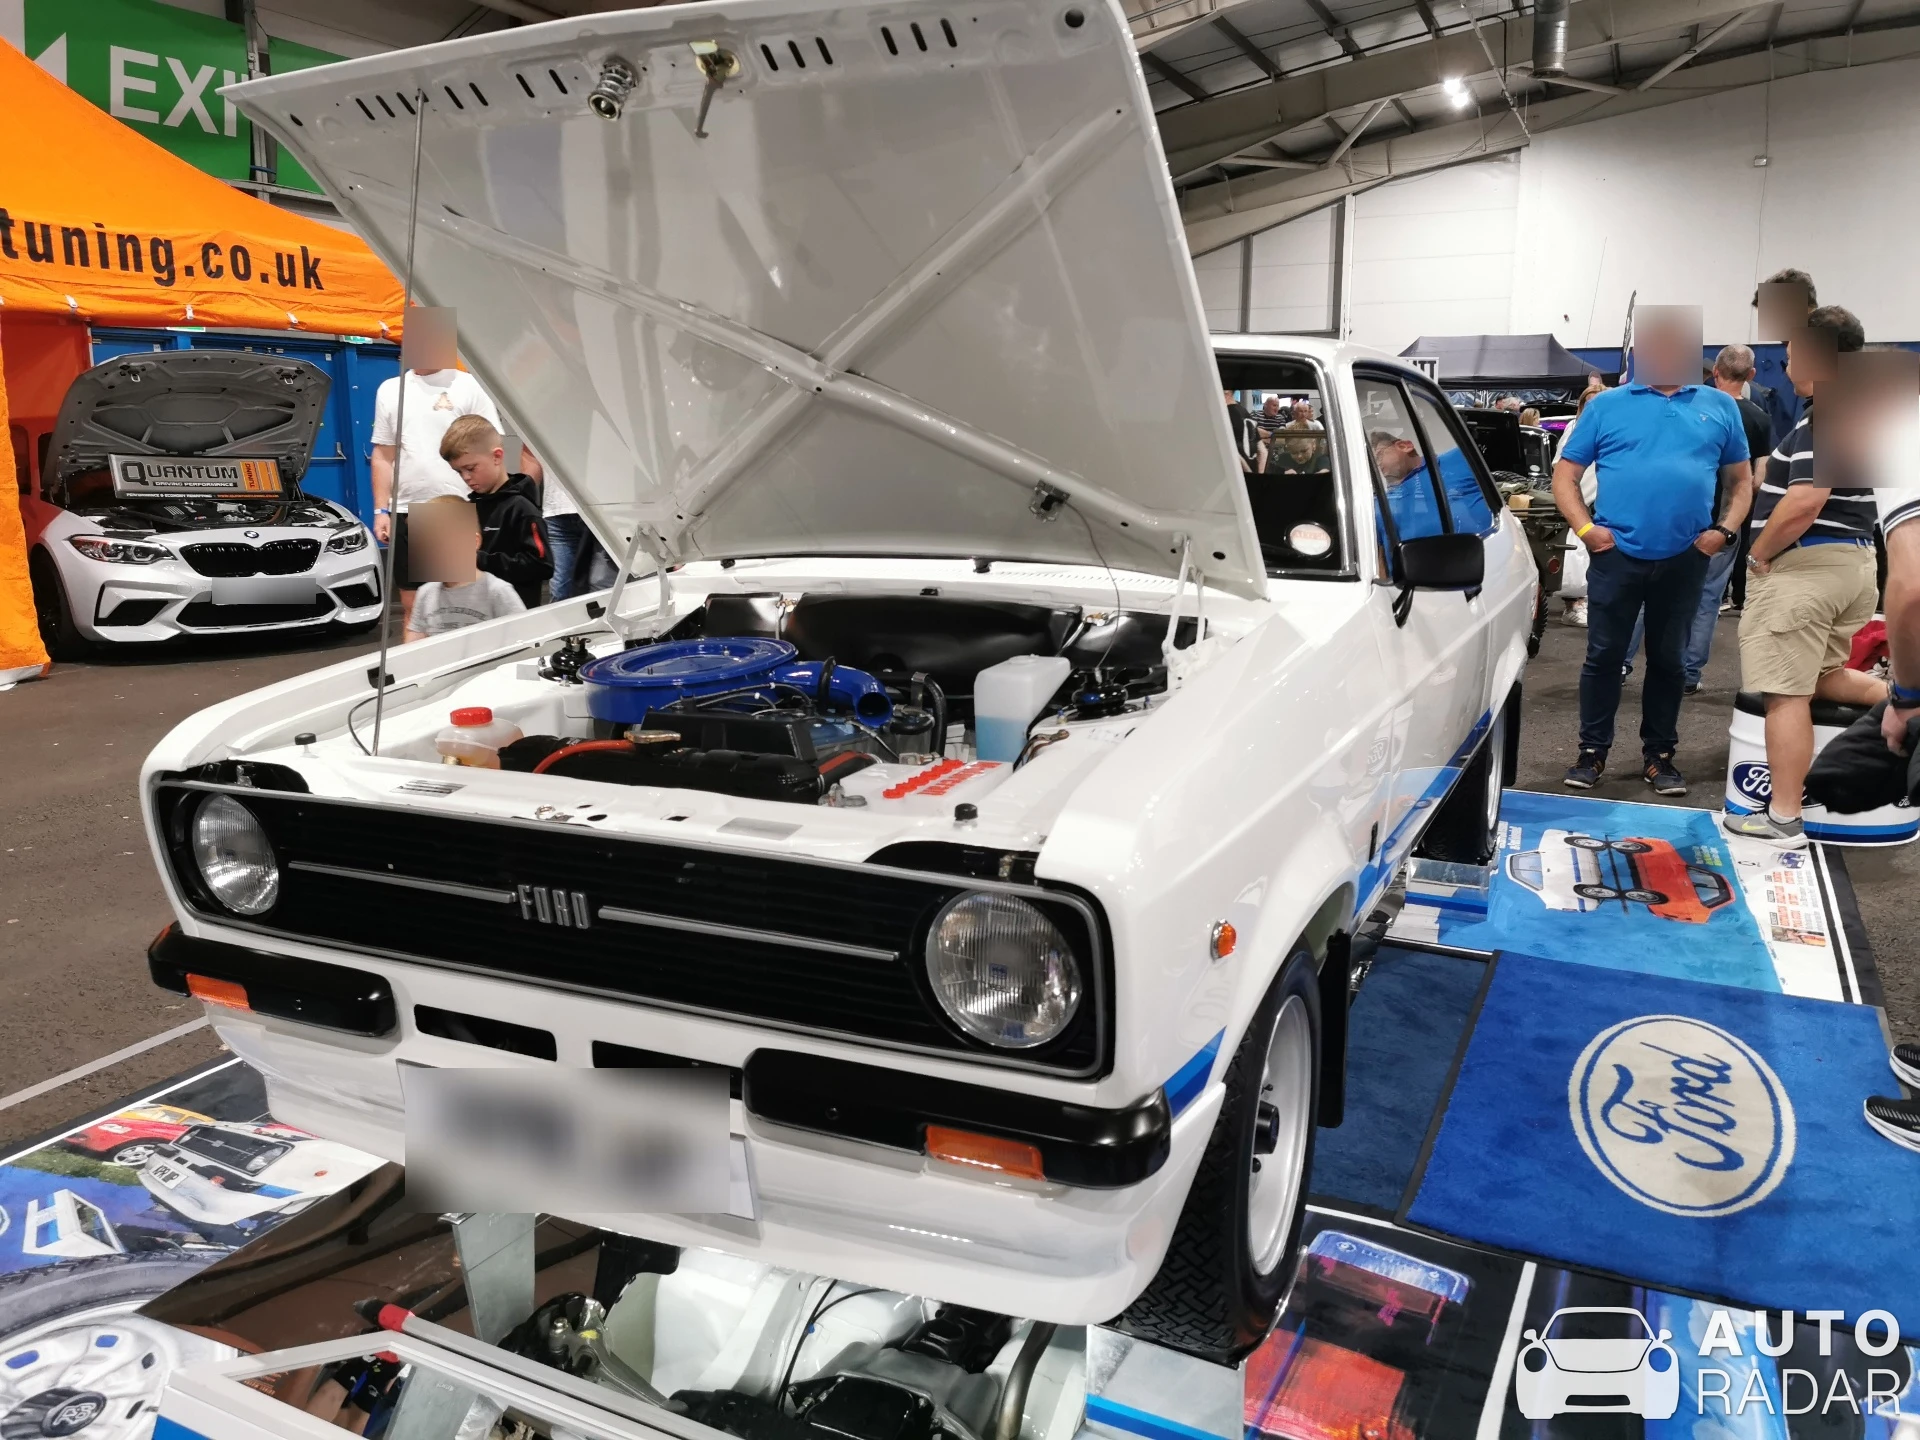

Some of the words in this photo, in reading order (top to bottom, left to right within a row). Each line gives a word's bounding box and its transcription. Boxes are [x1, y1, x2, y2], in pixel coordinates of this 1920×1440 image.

[110, 45, 249, 137] EXI
[121, 460, 239, 486] QUANTUM
[244, 463, 255, 488] TUNING
[517, 874, 591, 929] FORD
[1601, 1042, 1744, 1171] Ford
[53, 1402, 97, 1425] RS
